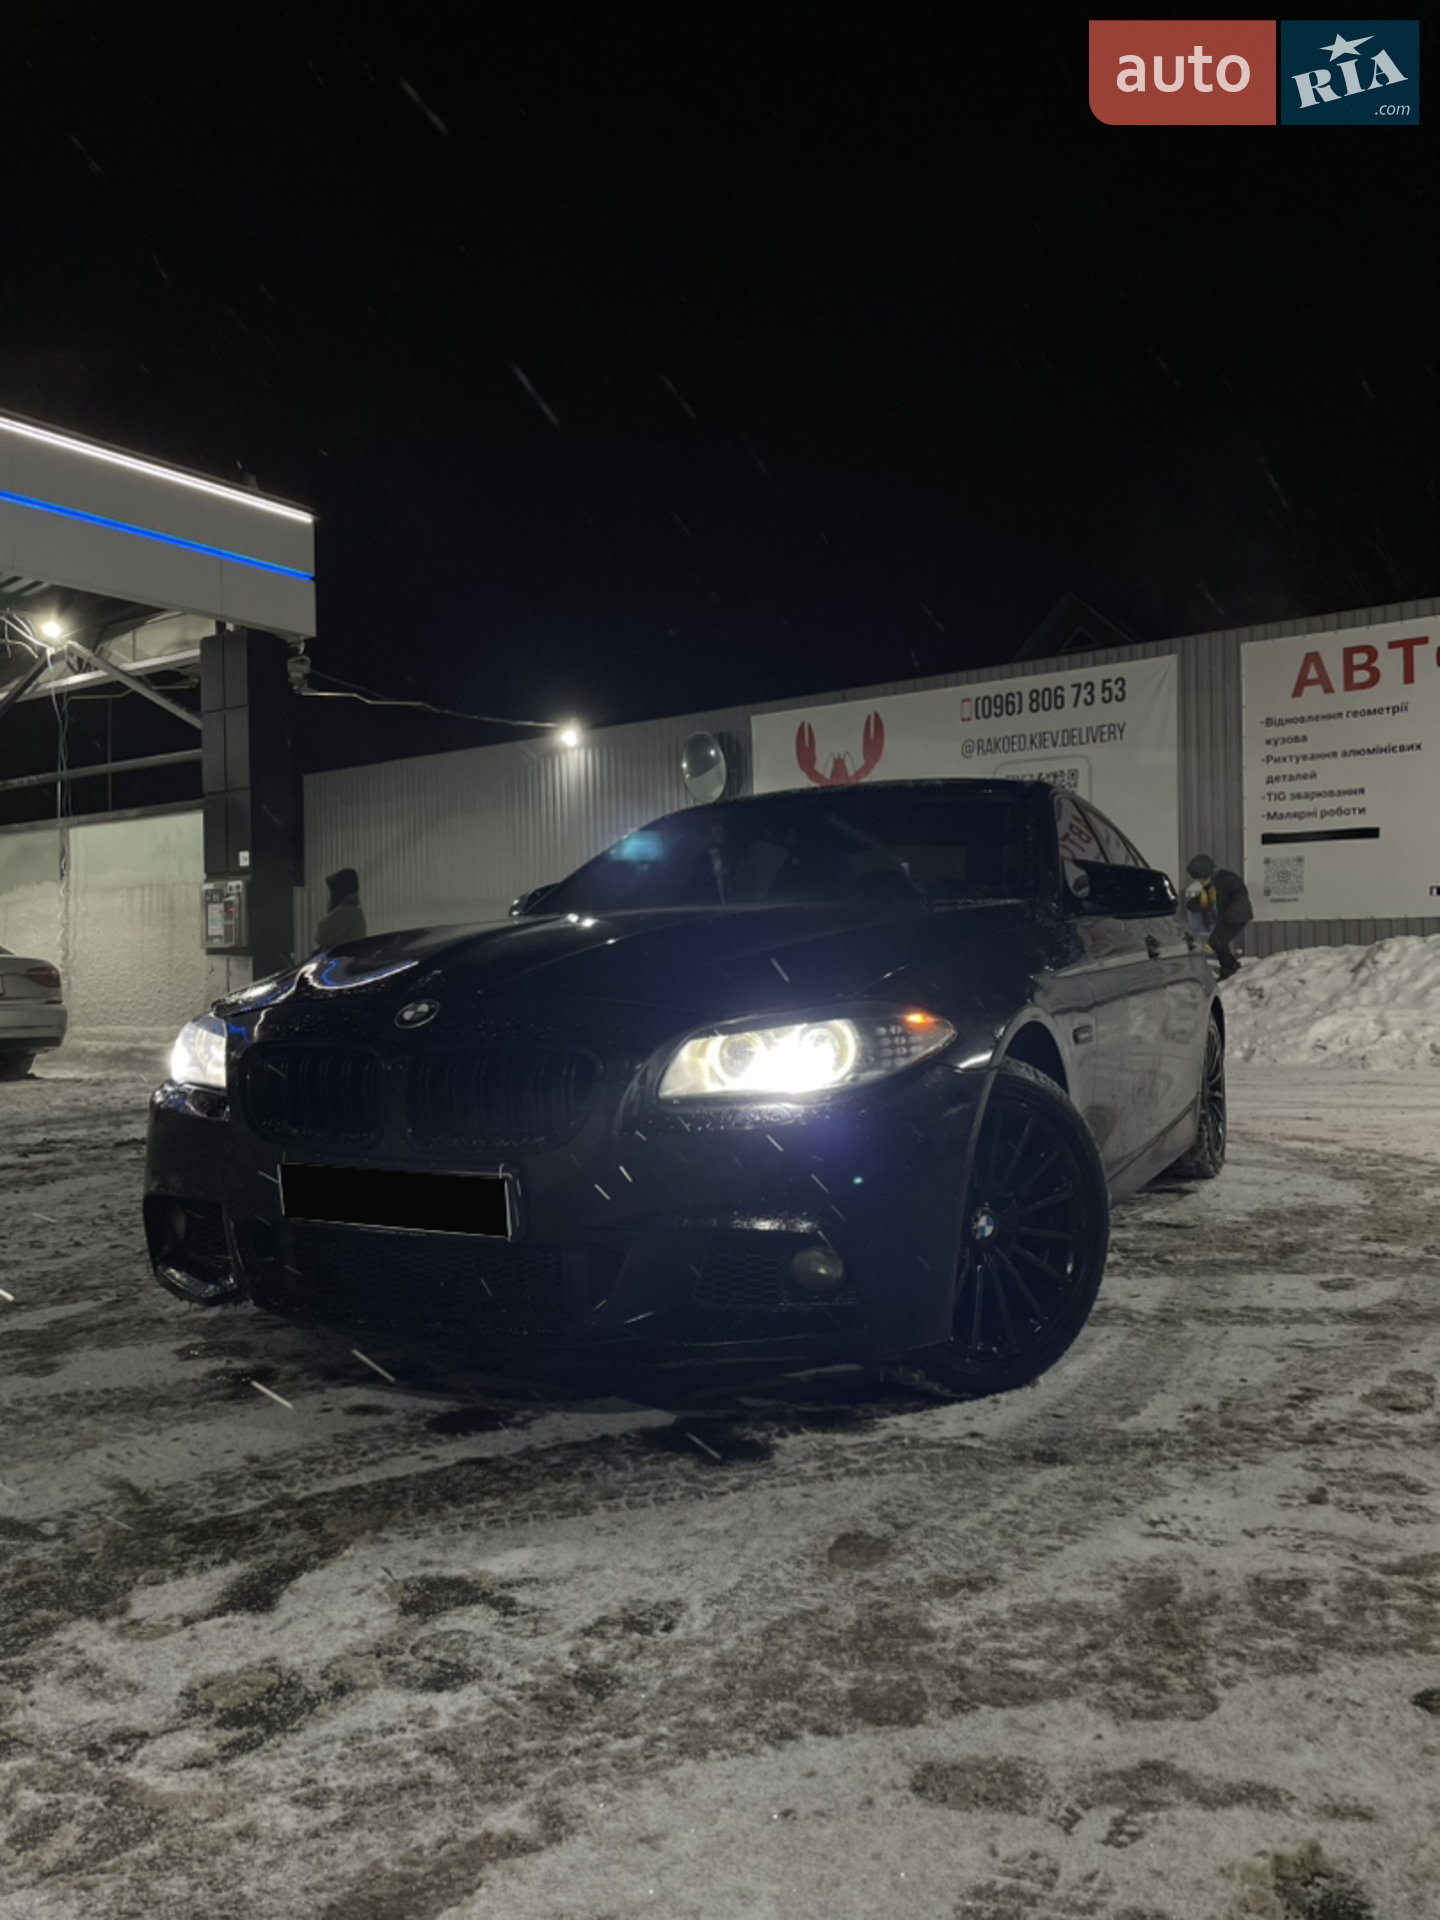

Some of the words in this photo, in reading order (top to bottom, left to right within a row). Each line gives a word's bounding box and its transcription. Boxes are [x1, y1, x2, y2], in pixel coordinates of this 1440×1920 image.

[1291, 636, 1440, 699] АВТ
[974, 691, 1023, 721] (096)
[1028, 685, 1066, 714] 806
[1070, 681, 1095, 709] 73
[1101, 676, 1127, 705] 53
[1345, 701, 1409, 721] геометрії
[961, 721, 1127, 760] @RAKOED.KIEV.DELIVERY
[1265, 733, 1308, 748] кузова
[1340, 742, 1423, 759] алюмінієвих
[1265, 770, 1318, 786] деталей
[1289, 786, 1366, 802] зварювання
[1320, 805, 1367, 820] роботи
